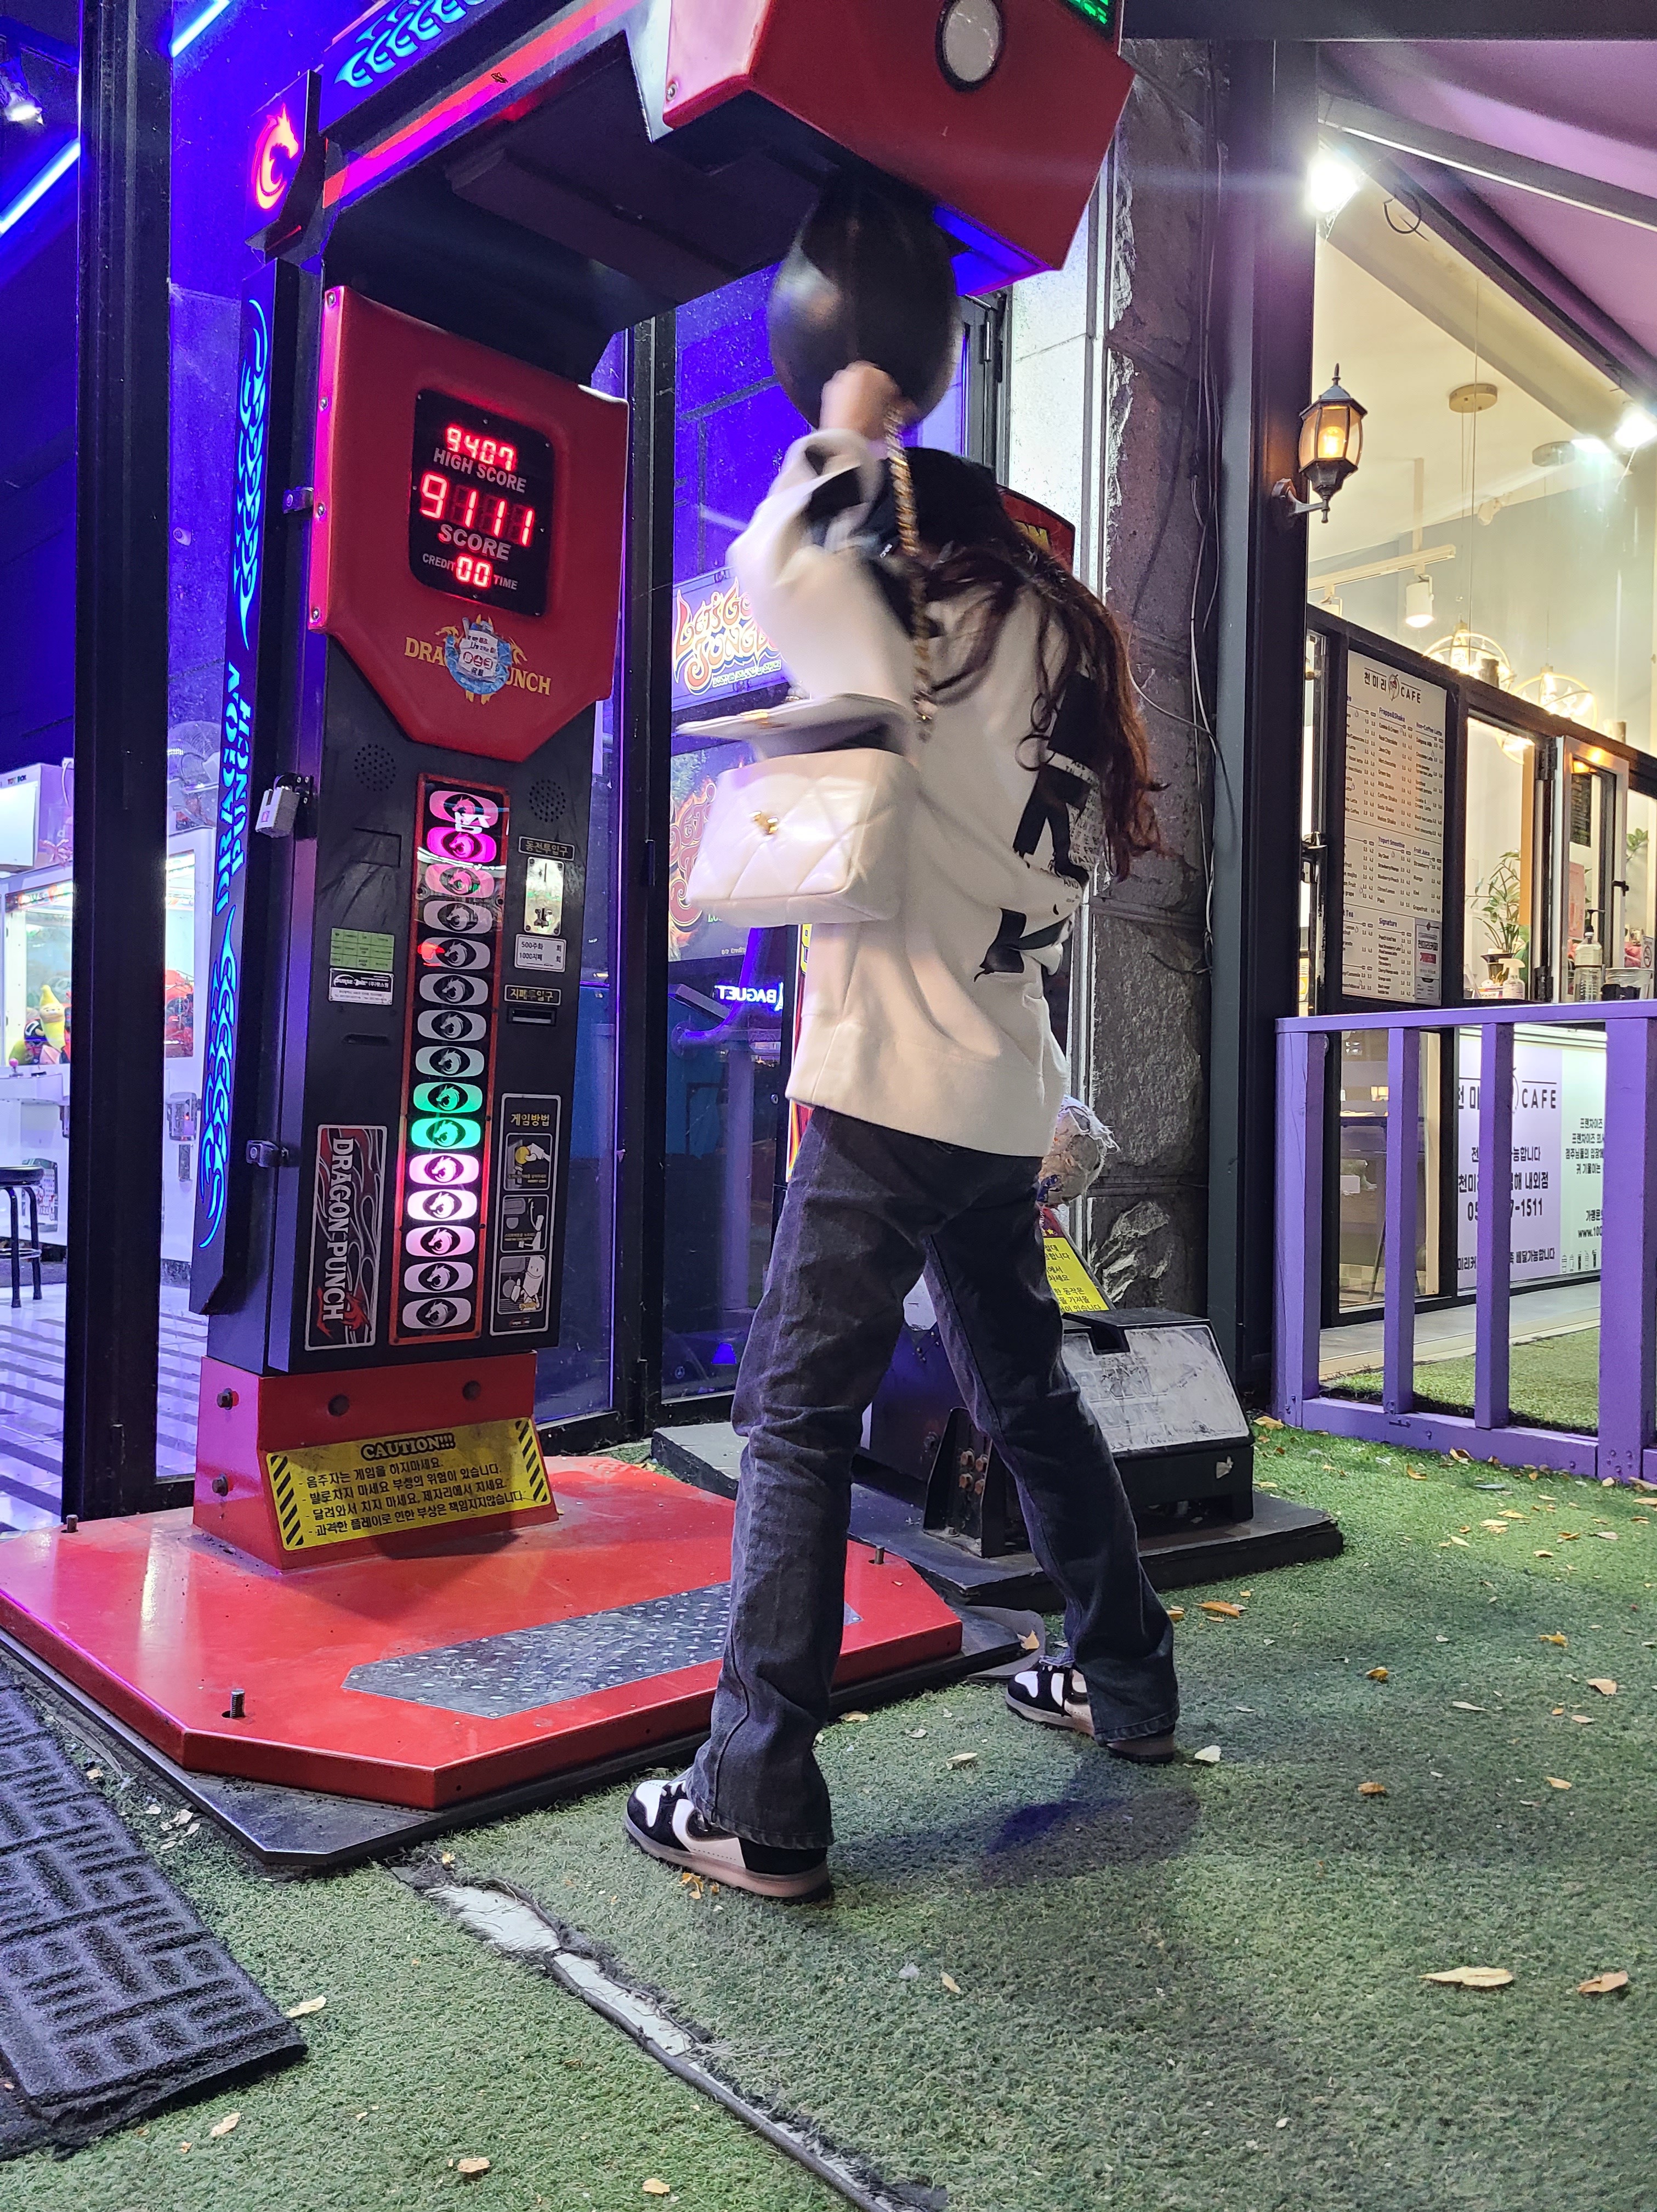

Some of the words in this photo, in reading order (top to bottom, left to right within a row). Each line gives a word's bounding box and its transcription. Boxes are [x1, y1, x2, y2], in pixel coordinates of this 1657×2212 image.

[433, 448, 473, 474] HIGH
[476, 463, 527, 493] SCORE
[420, 473, 533, 546] 9111
[439, 523, 511, 561] SCORE
[422, 552, 456, 571] CREDIT
[493, 575, 518, 591] TIME
[405, 637, 446, 667] DRA
[504, 666, 552, 695] UNCH
[1400, 686, 1421, 704] CAFE
[525, 840, 569, 858] 동전투입구
[521, 941, 543, 951] 500주화
[510, 988, 553, 1002] 지폐투입구
[1522, 1088, 1556, 1109] CAFE
[510, 1113, 550, 1127] 게임방법
[1512, 1146, 1541, 1162] 능합니다
[327, 1138, 354, 1234] DRAGON
[1525, 1172, 1548, 1189] 내외점
[323, 1240, 348, 1321] PUNCH
[362, 1434, 455, 1459] CAUTION!!!
[307, 1472, 351, 1489] 음주자는
[354, 1466, 386, 1481] 게임을
[310, 1486, 354, 1504] 발로차지
[357, 1481, 390, 1496] 마세요
[460, 1463, 502, 1480] 있습니다.
[313, 1503, 357, 1521] 달려와서
[386, 1492, 421, 1508] 마세요,
[422, 1484, 472, 1502] 제자리에서
[350, 1513, 393, 1531] 플레이로
[394, 1509, 415, 1523] 인한
[417, 1504, 447, 1519] 부상은
